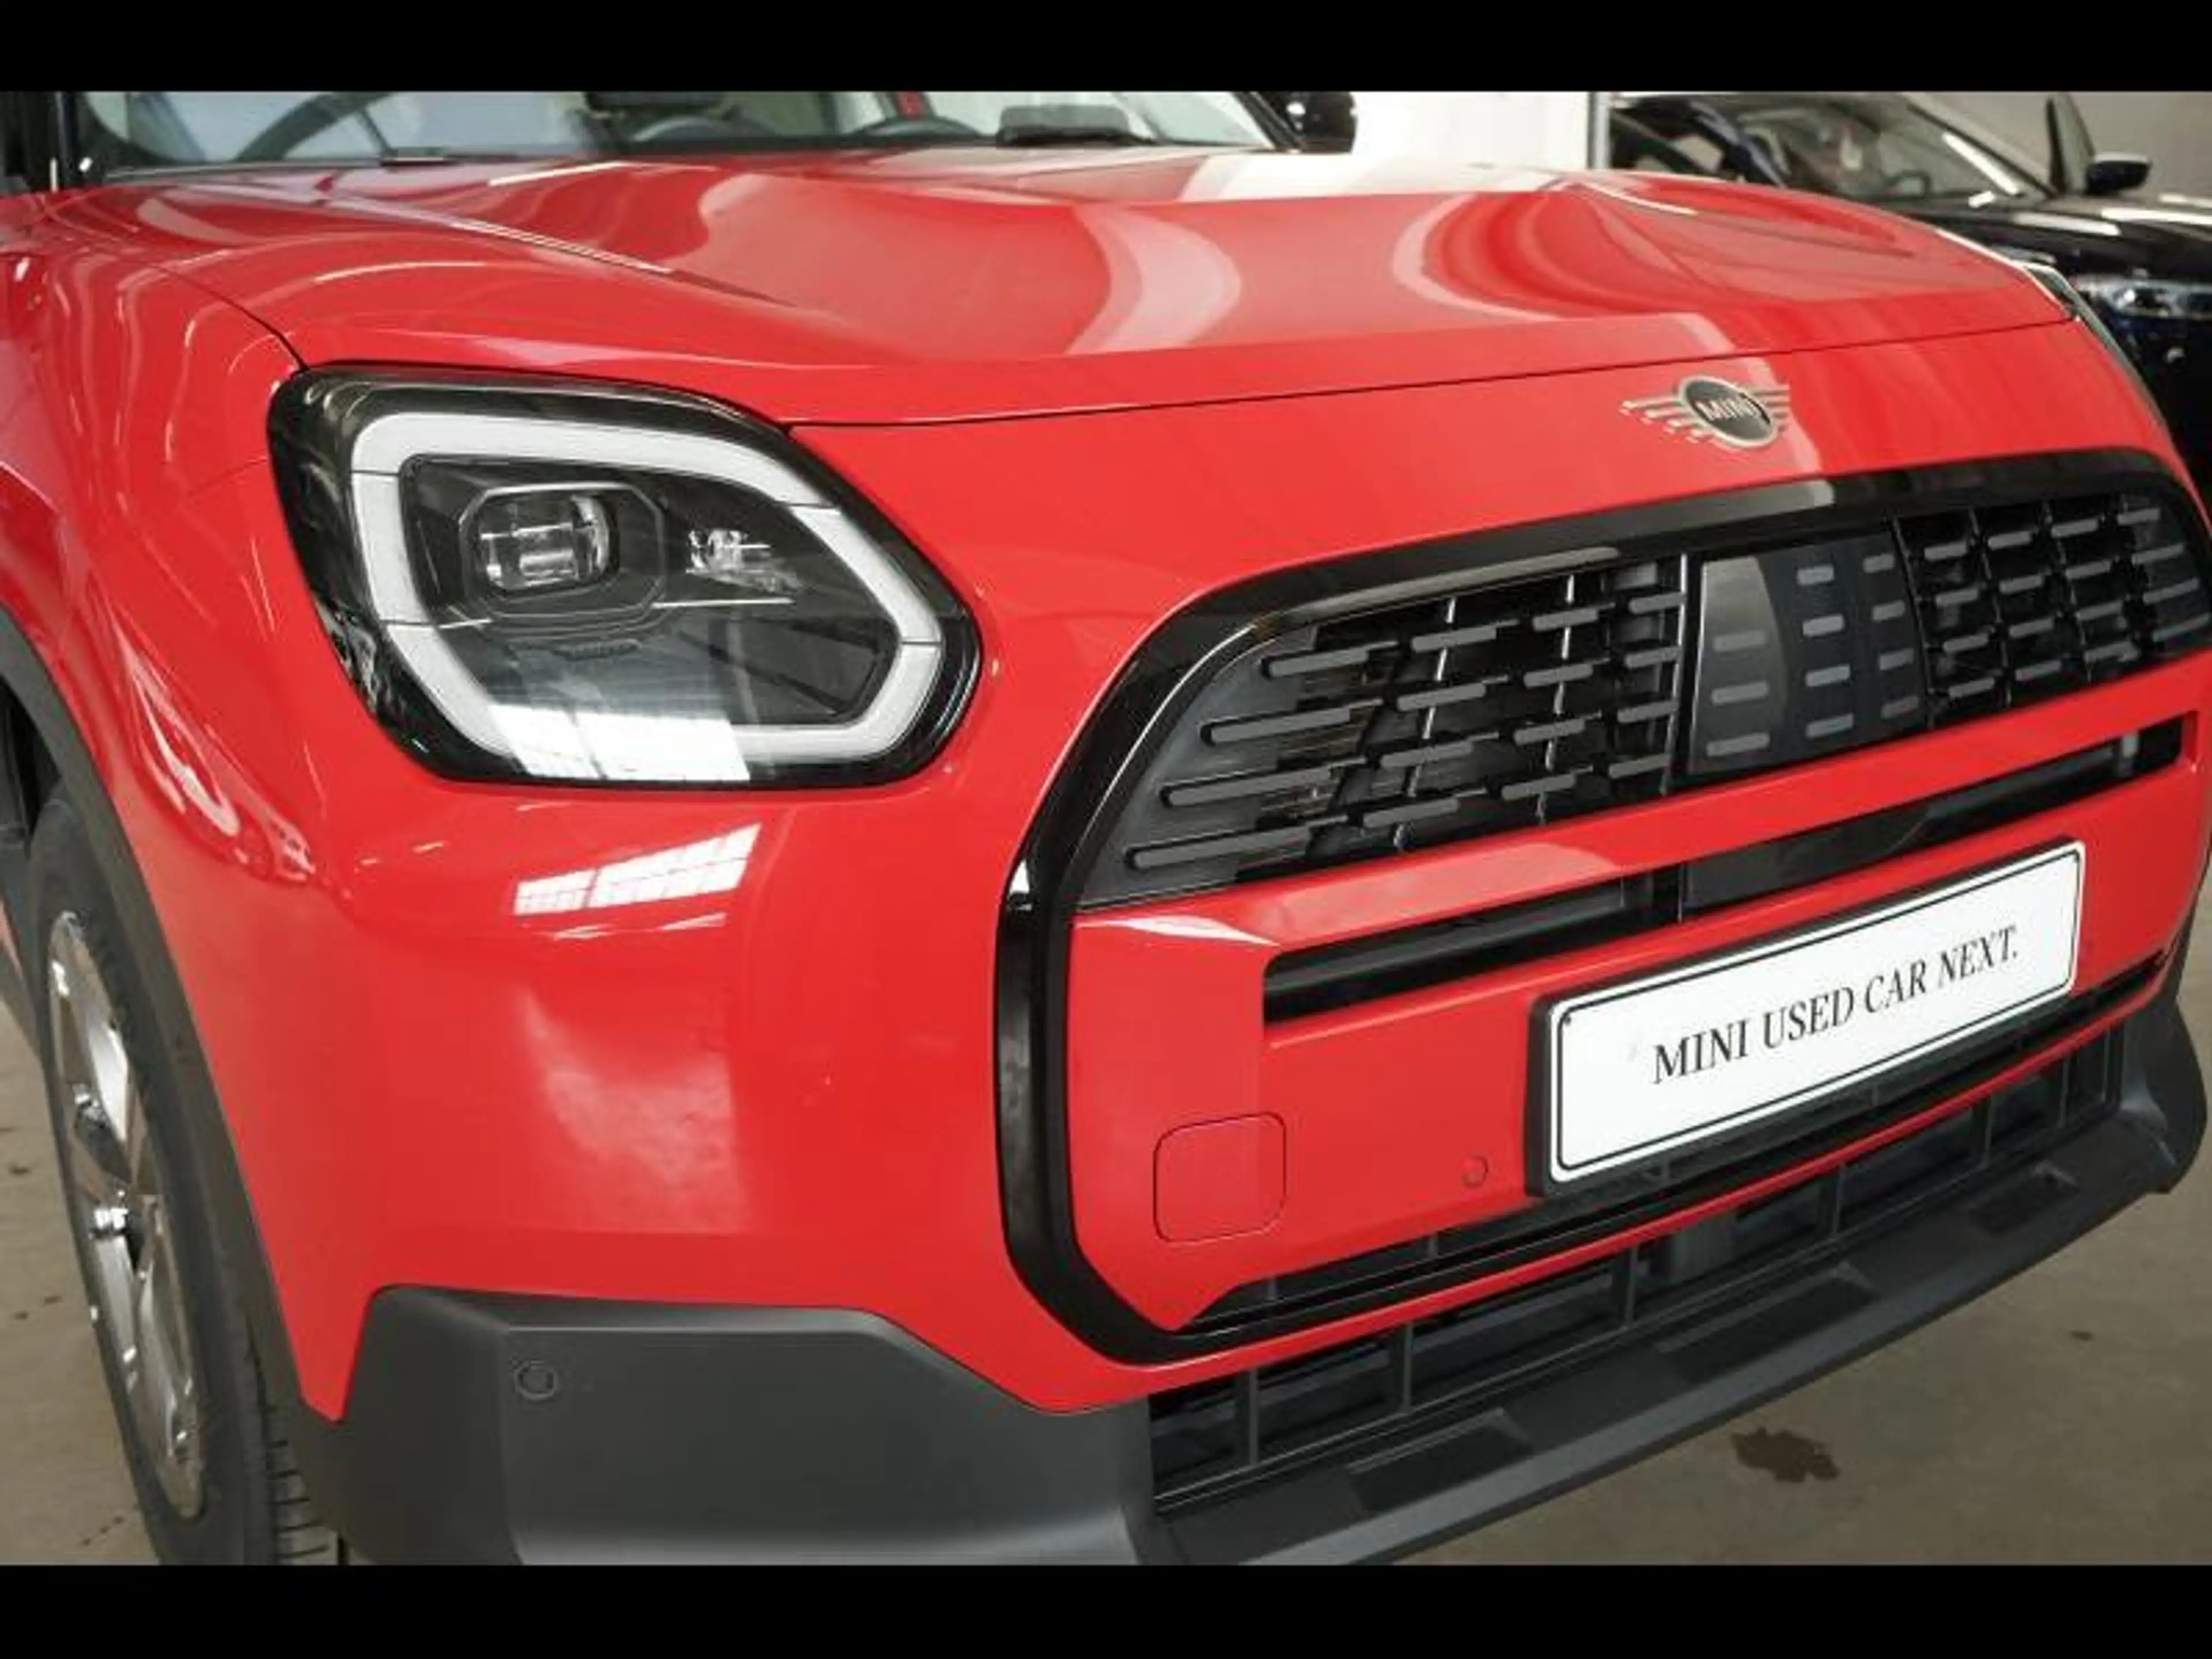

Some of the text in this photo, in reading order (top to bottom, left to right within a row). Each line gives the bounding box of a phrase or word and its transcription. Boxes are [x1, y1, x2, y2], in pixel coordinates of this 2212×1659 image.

[1653, 925, 2018, 1084] MINI USED CAR NEXT.
